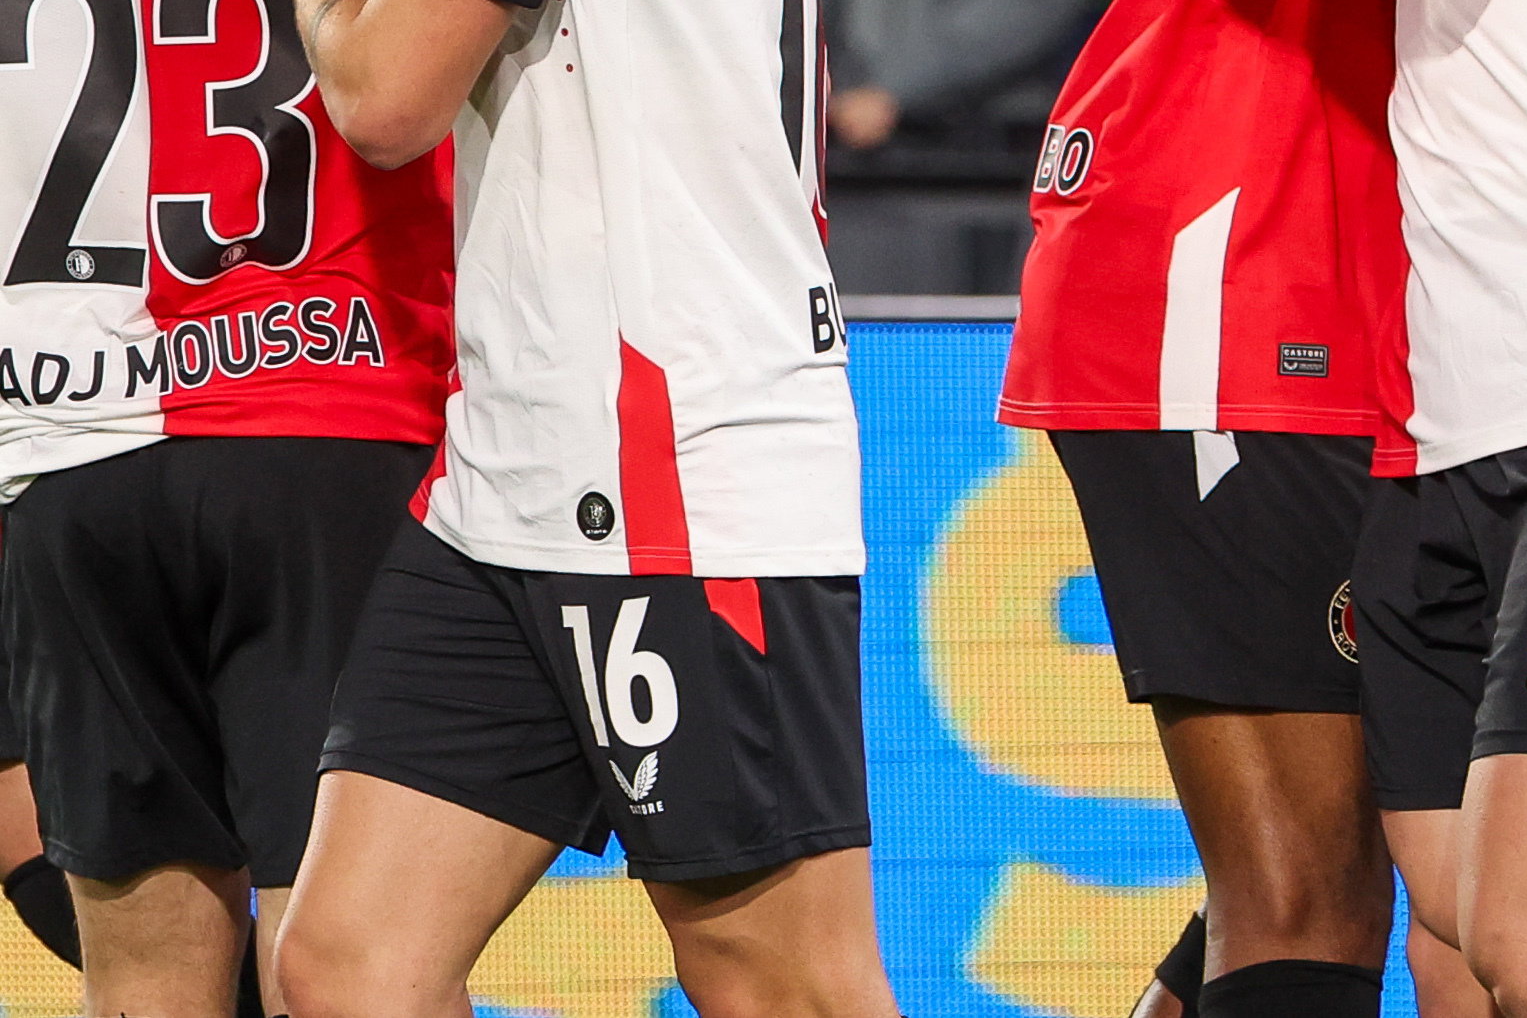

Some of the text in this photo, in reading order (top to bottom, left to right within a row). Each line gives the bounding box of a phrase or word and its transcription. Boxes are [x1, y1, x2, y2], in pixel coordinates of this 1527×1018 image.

[124, 296, 385, 400] MOUSSA
[1284, 349, 1324, 357] CASTORE
[560, 596, 679, 748] 16
